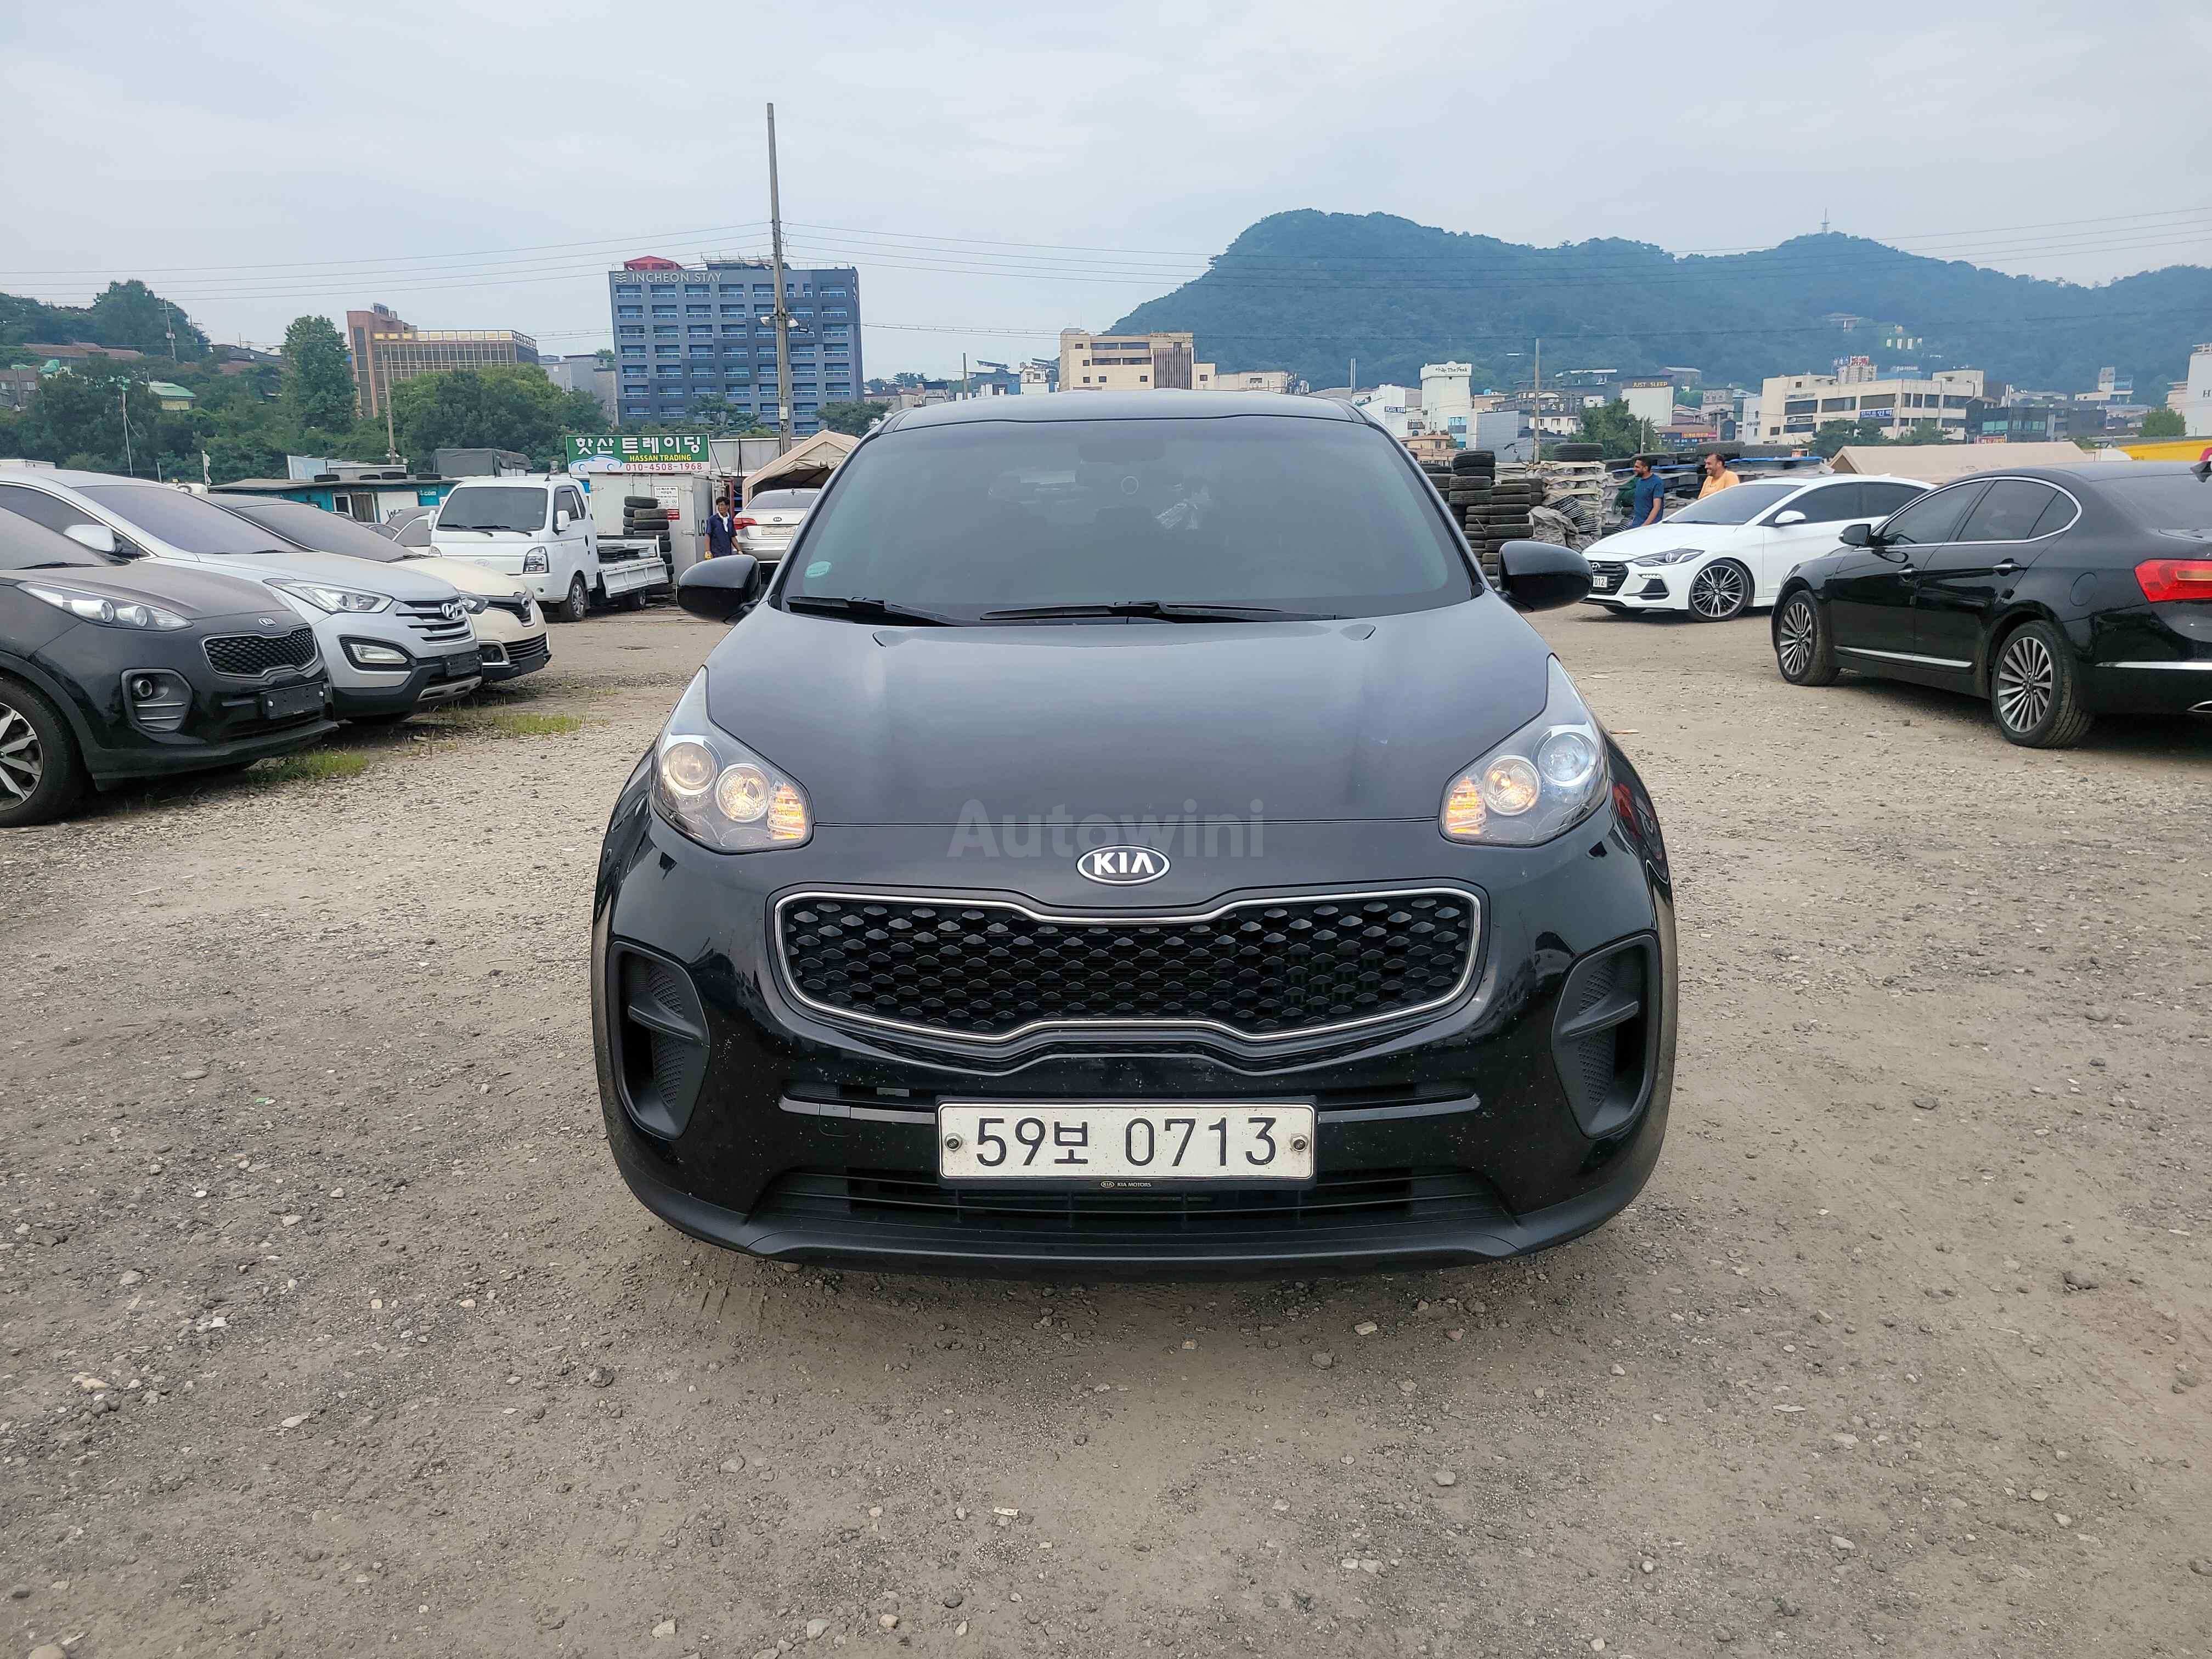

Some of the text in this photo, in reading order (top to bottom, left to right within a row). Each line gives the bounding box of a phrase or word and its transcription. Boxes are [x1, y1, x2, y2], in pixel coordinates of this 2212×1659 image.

[633, 273, 721, 283] INCHEON STAY
[575, 436, 701, 455] 핫산 트레이딩
[626, 462, 702, 471] 010-4508-1968
[1092, 852, 1155, 876] KIA
[977, 1116, 1277, 1166] 59보 0713
